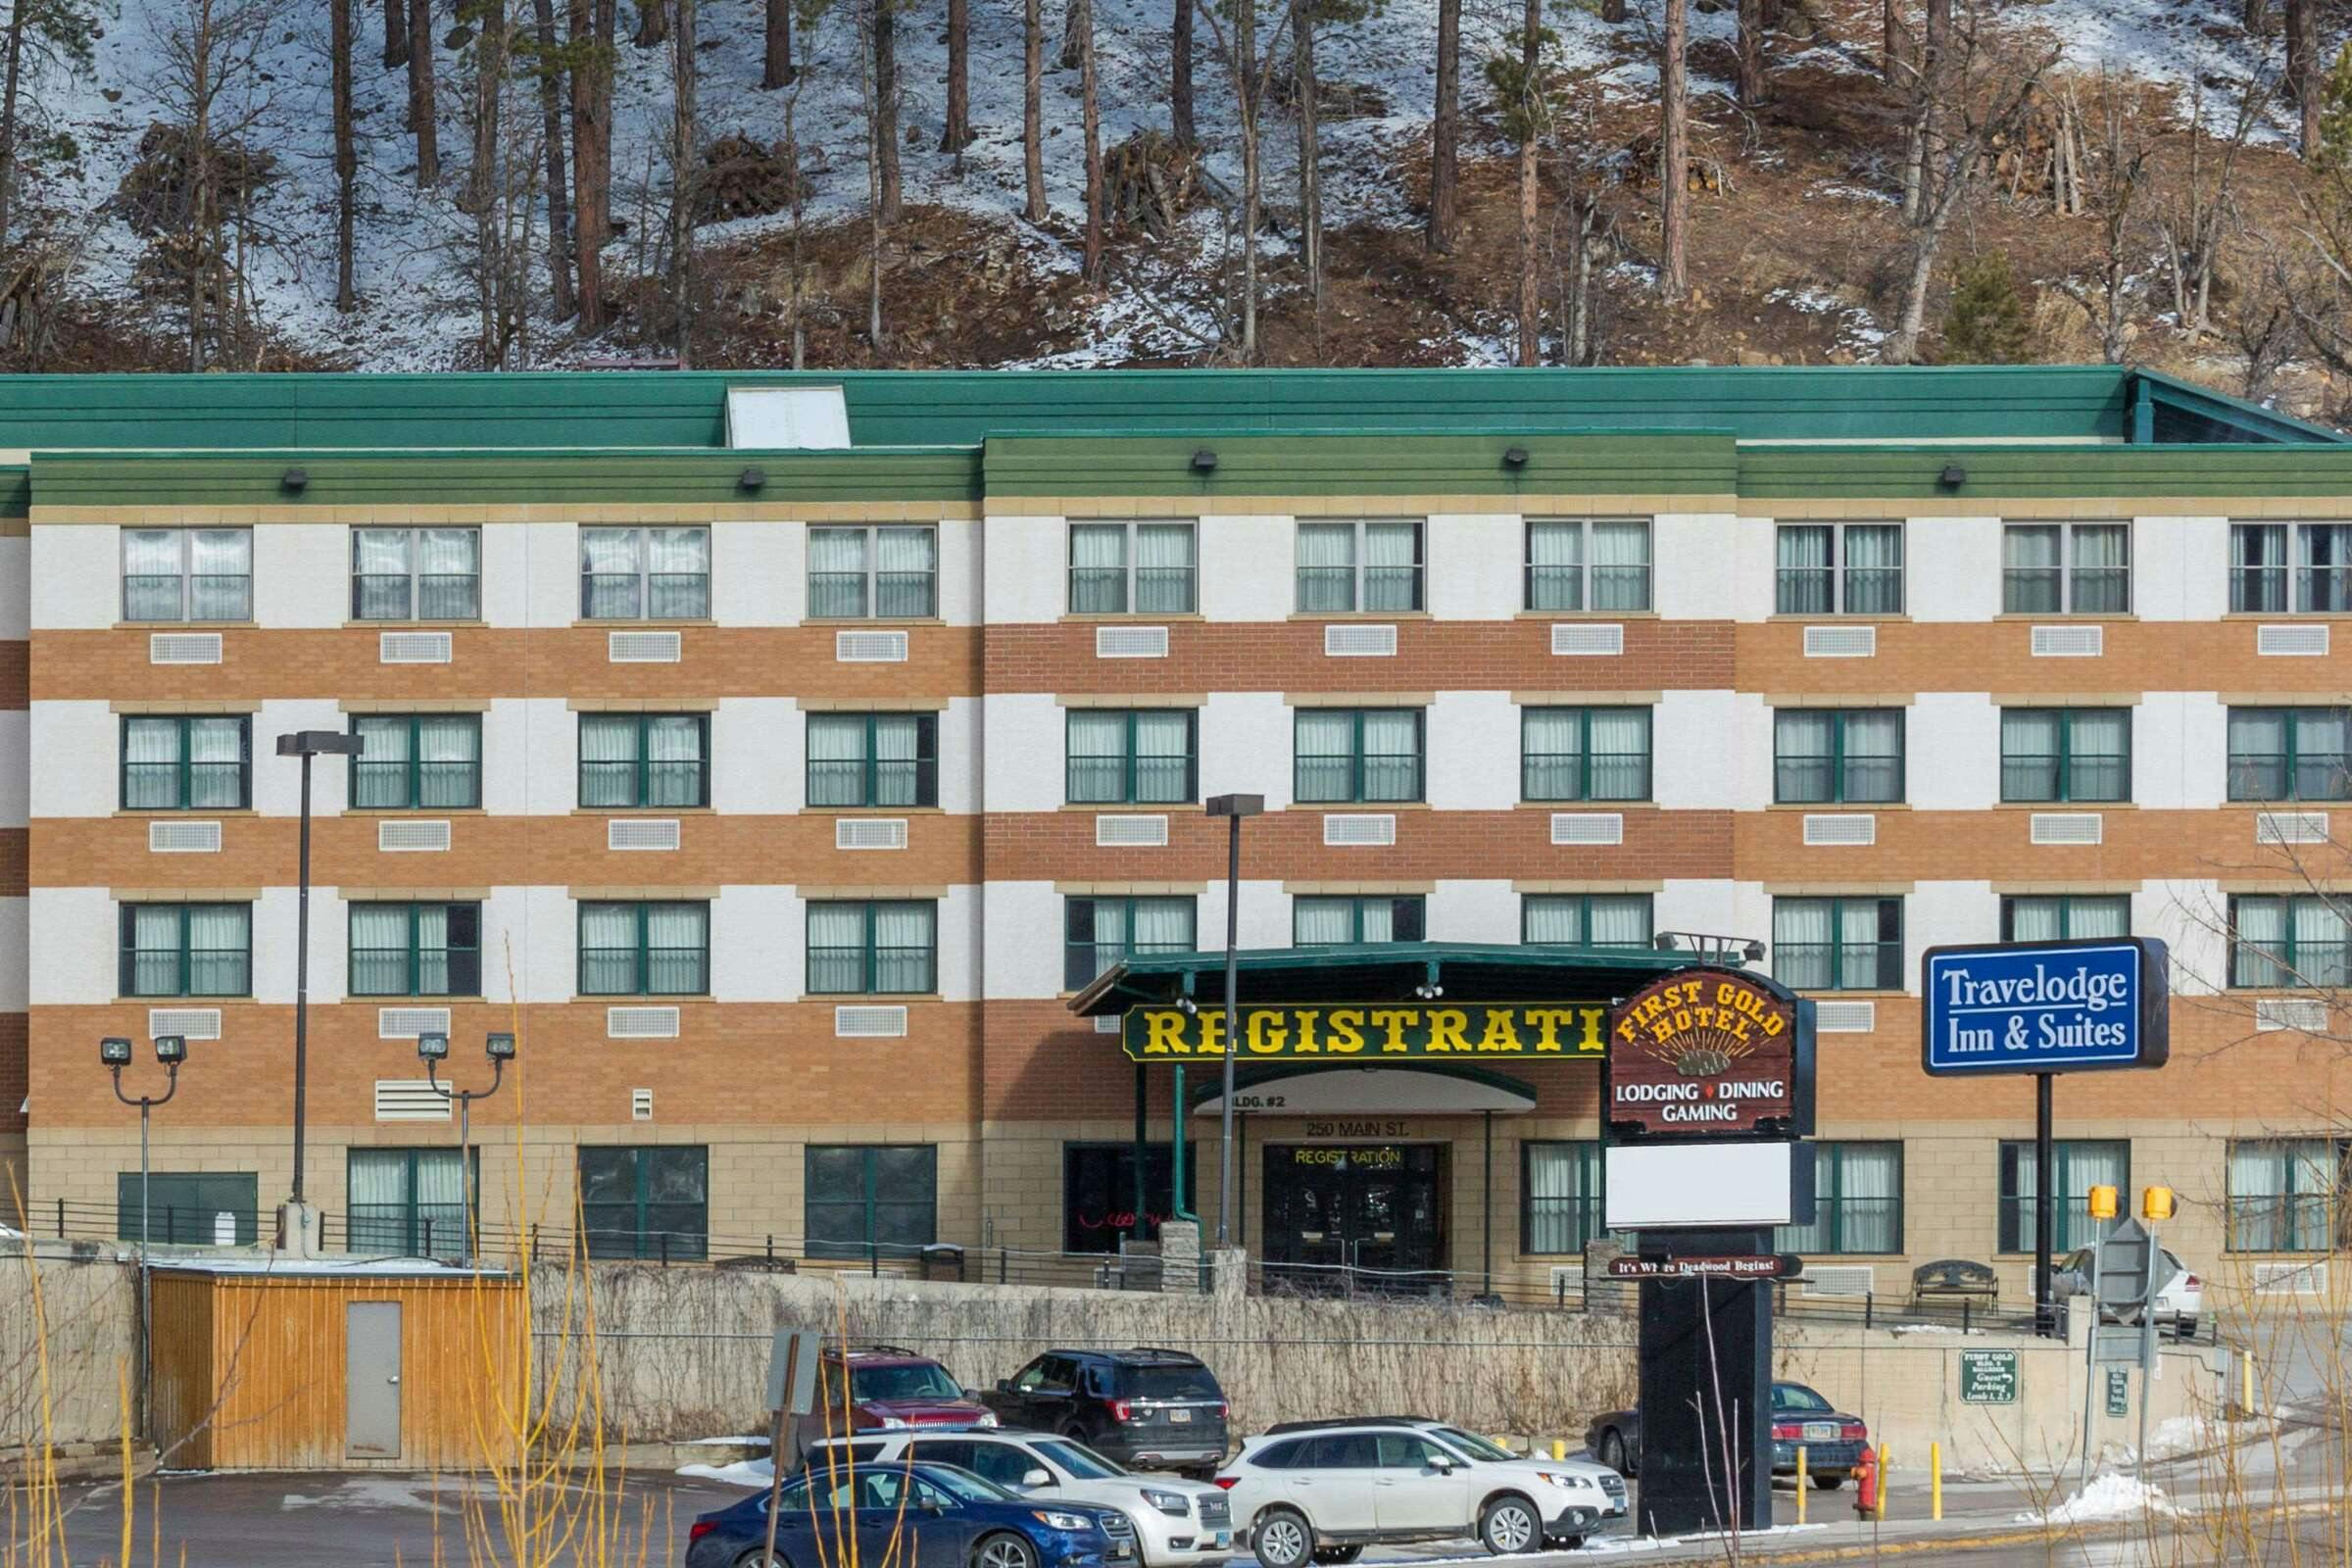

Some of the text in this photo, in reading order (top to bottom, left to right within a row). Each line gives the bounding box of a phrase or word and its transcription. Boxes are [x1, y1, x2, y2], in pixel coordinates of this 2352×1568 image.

[1941, 964, 2128, 1012] Travelodge
[1617, 981, 1786, 1044] FIRST GOLD
[1650, 1007, 1750, 1045] HOTEL
[1948, 1012, 2127, 1053] Inn & Suites
[1232, 1097, 1286, 1107] LDG. #2
[1616, 1081, 1784, 1102] LODGING DINING
[1662, 1103, 1738, 1123] GAMING
[1306, 1121, 1410, 1137] 250 MAIN ST.
[1618, 1259, 1774, 1274] It's Whre Deadwood Begins!
